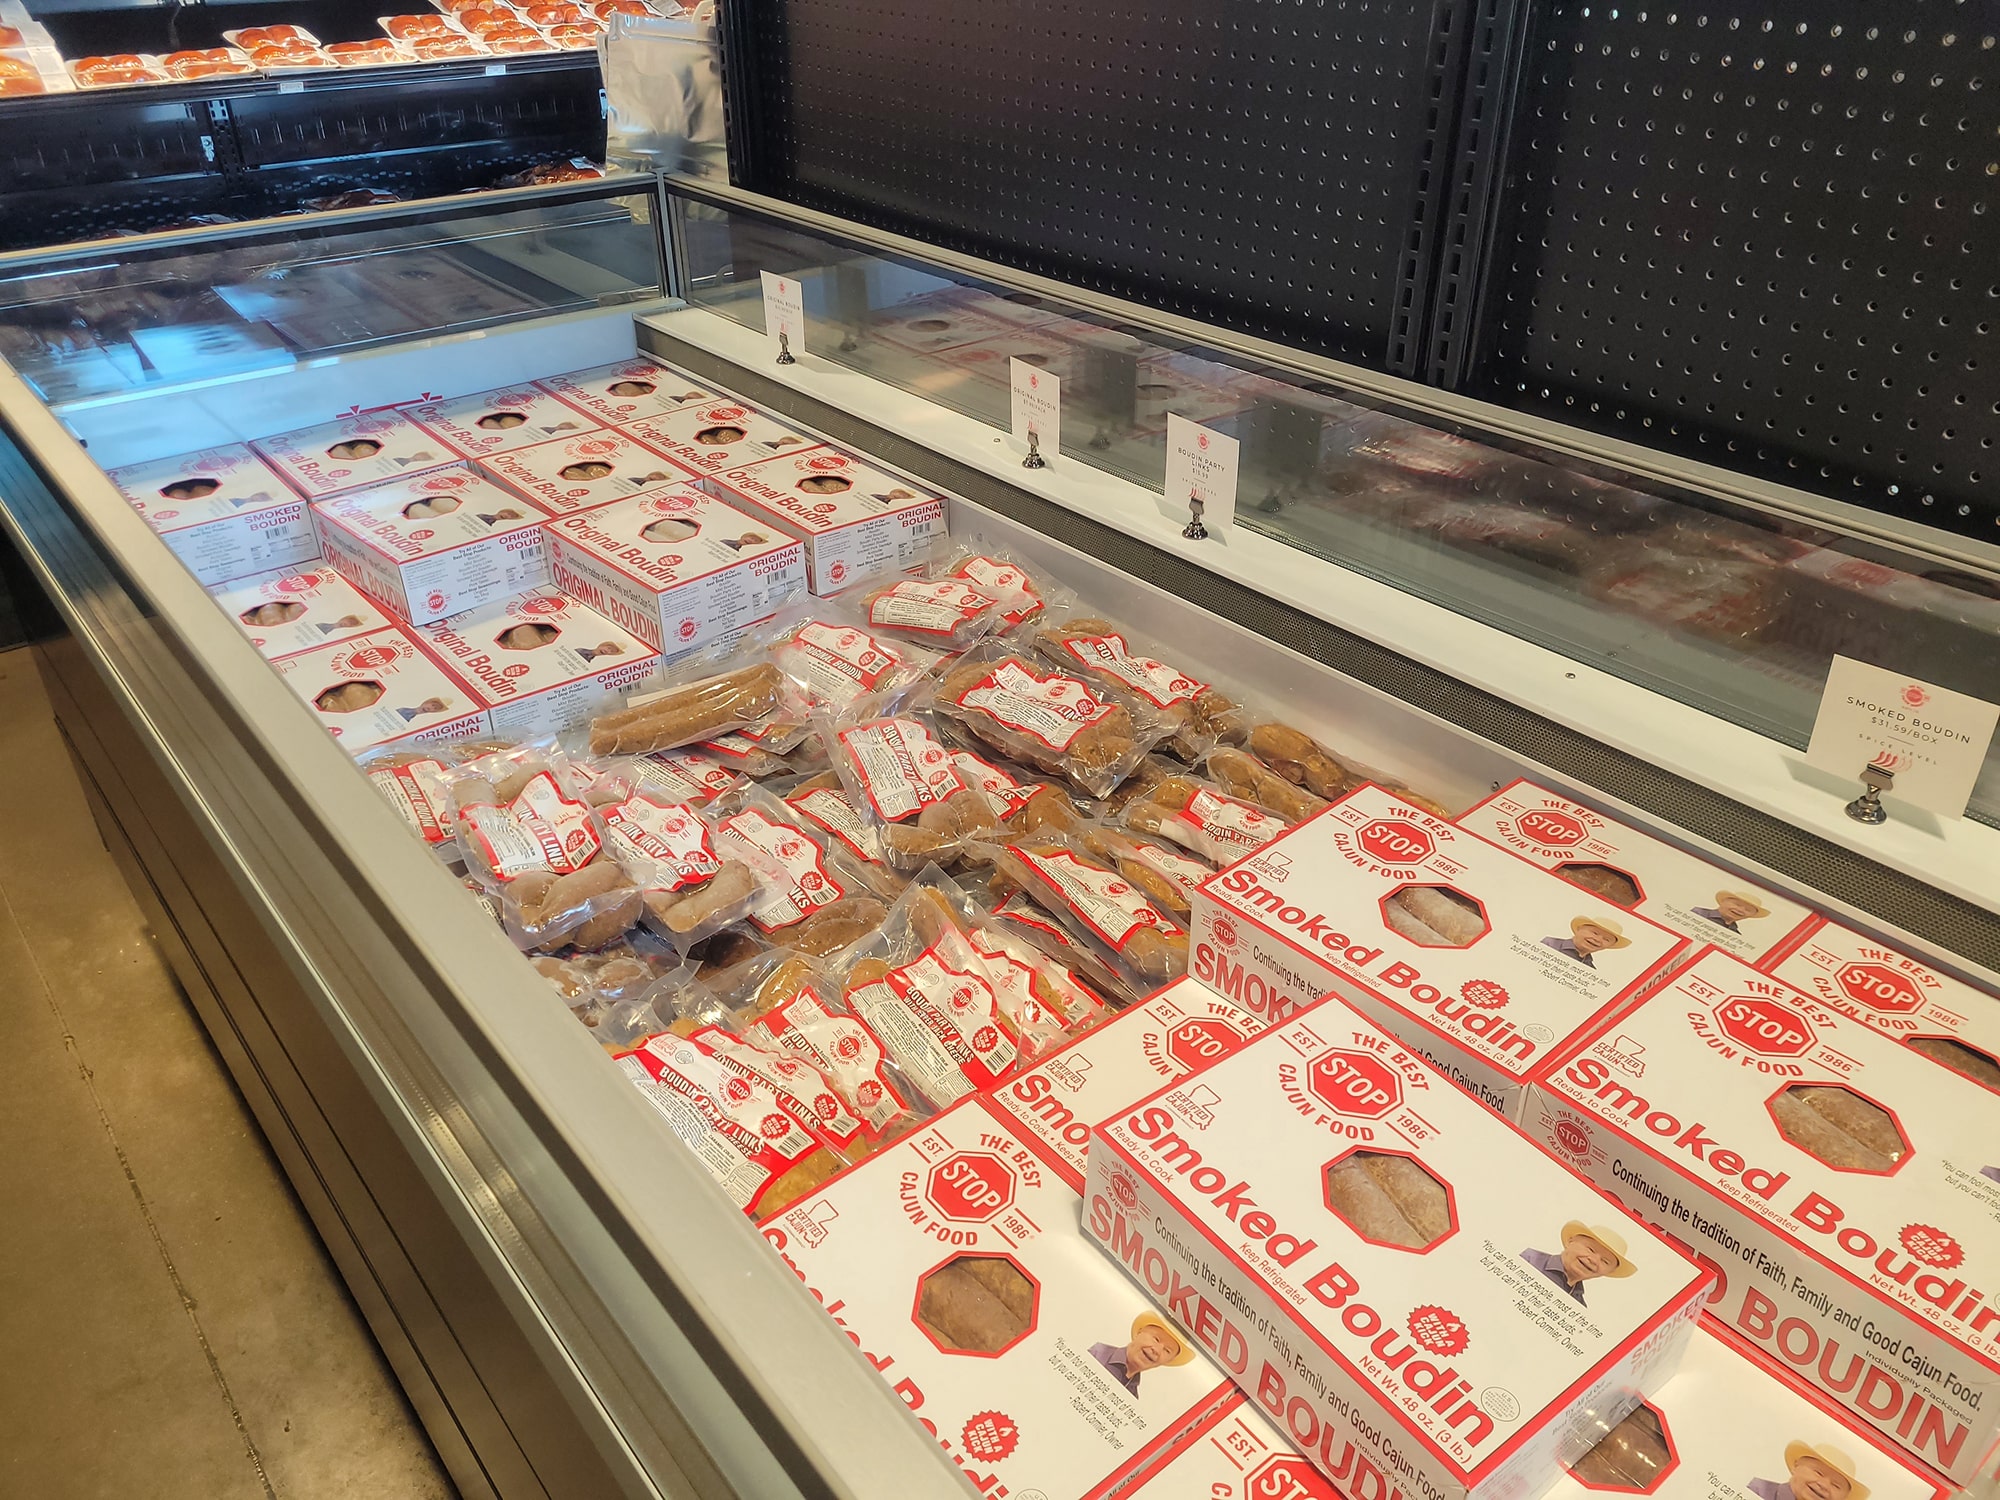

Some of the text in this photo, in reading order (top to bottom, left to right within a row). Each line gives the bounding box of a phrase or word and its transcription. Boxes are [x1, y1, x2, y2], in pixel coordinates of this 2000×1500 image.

[550, 377, 630, 423] Original Boudin
[1013, 386, 1036, 402] ORIGINAL
[1037, 397, 1056, 411] BOUDIN
[418, 406, 493, 454] Original Boudin
[632, 422, 723, 472] Original Boudin
[1177, 447, 1226, 472] BOUDIN PARTY
[494, 455, 580, 510] Original Boudin
[1191, 460, 1210, 473] LINKS
[244, 504, 302, 525] SMOKED
[661, 497, 689, 510] STOP
[726, 470, 833, 528] Original Boudin
[897, 502, 946, 521] ORIGINAL
[249, 513, 301, 532] BOUDIN
[331, 498, 424, 556] Original Boudin
[499, 526, 541, 545] ORIGIN
[902, 511, 942, 528] BOUDIN
[563, 518, 630, 553] Original
[617, 547, 679, 584] Boudin
[749, 546, 801, 571] ORIGINAL
[754, 556, 798, 577] BOUDIN
[287, 576, 311, 591] STOP
[530, 597, 558, 613] STOP
[552, 562, 610, 617] ORIGINAL
[609, 596, 662, 650] BOUDIN
[359, 648, 386, 667] STOP
[423, 618, 518, 699] Original Boudin
[596, 658, 658, 684] ORIGINAL
[604, 668, 654, 691] BOUDIN
[414, 716, 485, 744] ORIGINAL
[1846, 696, 1971, 744] SMOKED BOUDIN
[1871, 716, 1938, 745] $31.59/BOX
[1858, 733, 1938, 765] SPICE LEVEL
[1388, 806, 1456, 842] THE BEST
[1523, 814, 1580, 842] STOP
[1541, 798, 1606, 830] THE BEST
[1333, 831, 1418, 880] CAJUN FOOD
[1366, 823, 1426, 858] STOP
[1495, 820, 1576, 859] CAJUN FOOD
[1431, 858, 1460, 876] 1986
[1214, 923, 1235, 941] STOP
[1221, 869, 1385, 968] Smoked
[1377, 961, 1537, 1062] Boudin
[1253, 945, 1292, 986] Continuing
[1292, 971, 1306, 992] the
[1857, 947, 1943, 990] THE BEST
[1688, 981, 1716, 1001] EST.
[1845, 968, 1915, 1006] STOP
[1155, 1004, 1178, 1023] EST.
[1744, 980, 1838, 1030] THE BEST
[1928, 1008, 1959, 1027] 1986
[783, 1026, 815, 1056] BOUDIN
[1291, 1030, 1318, 1052] EST.
[1726, 1003, 1804, 1046] STOP
[841, 1038, 858, 1056] STOP
[1142, 1032, 1173, 1077] CAJUN
[1591, 1044, 1623, 1067] CAJUN
[1596, 1040, 1641, 1070] CERTIFIED
[1687, 1011, 1804, 1077] CAJUN FOOD
[1351, 1031, 1431, 1091] THE BEST
[1817, 1050, 1853, 1073] 1986
[728, 1081, 749, 1099] STOP
[1319, 1056, 1390, 1108] STOP
[658, 1066, 698, 1099] BOUDIN
[732, 1126, 766, 1155] LINKS
[750, 1074, 789, 1103] PARTY
[787, 1093, 822, 1130] LINKS
[1164, 1094, 1192, 1116] CAJUN
[1172, 1089, 1208, 1121] CERTIFIED
[1278, 1062, 1375, 1142] CAJUN FOOD
[1552, 1075, 1631, 1130] Ready to Cook
[1395, 1113, 1429, 1140] 1986
[1558, 1125, 1587, 1149] STOP
[724, 1132, 755, 1160] CHEESE
[921, 1136, 946, 1158] EST.
[980, 1132, 1042, 1190] THE BEST
[1110, 1125, 1176, 1185] Ready to Cook
[941, 1159, 1002, 1210] STOP
[1113, 1178, 1134, 1202] STOP
[899, 1170, 979, 1246] CAJUN FOOD
[1565, 1058, 1792, 1199] Smoked
[1790, 1190, 2000, 1346] Boudin
[1716, 1177, 1800, 1234] Keep Refrigerated
[793, 1207, 822, 1239] CERTIFIED
[1002, 1214, 1030, 1239] 1986
[1089, 1193, 1250, 1377] SMOKED
[1127, 1106, 1319, 1270] Smoked
[1301, 1261, 1496, 1449] Boudin
[1238, 1241, 1307, 1307] Keep Refrigerated
[1612, 1158, 1984, 1412] Continuing the tradition of Faith, Family and Good Cajun Food.
[1514, 1298, 1585, 1358] Robert Cormier, Owner
[1154, 1216, 1200, 1276] Continuing
[1201, 1259, 1217, 1288] the
[1217, 1276, 1258, 1327] tradition
[1257, 1318, 1270, 1336] of
[1267, 1327, 1293, 1370] Faith,
[1293, 1352, 1330, 1400] Family
[1327, 1391, 1349, 1418] and
[1350, 1407, 1382, 1448] Good
[1382, 1436, 1415, 1480] Cajun
[1736, 1285, 1970, 1470] BOUDIN
[1865, 1350, 1973, 1425] Individually Packaged
[1358, 1354, 1473, 1465] Net Wt. 48 oz. (3 lb.)
[1226, 1430, 1257, 1461] EST.
